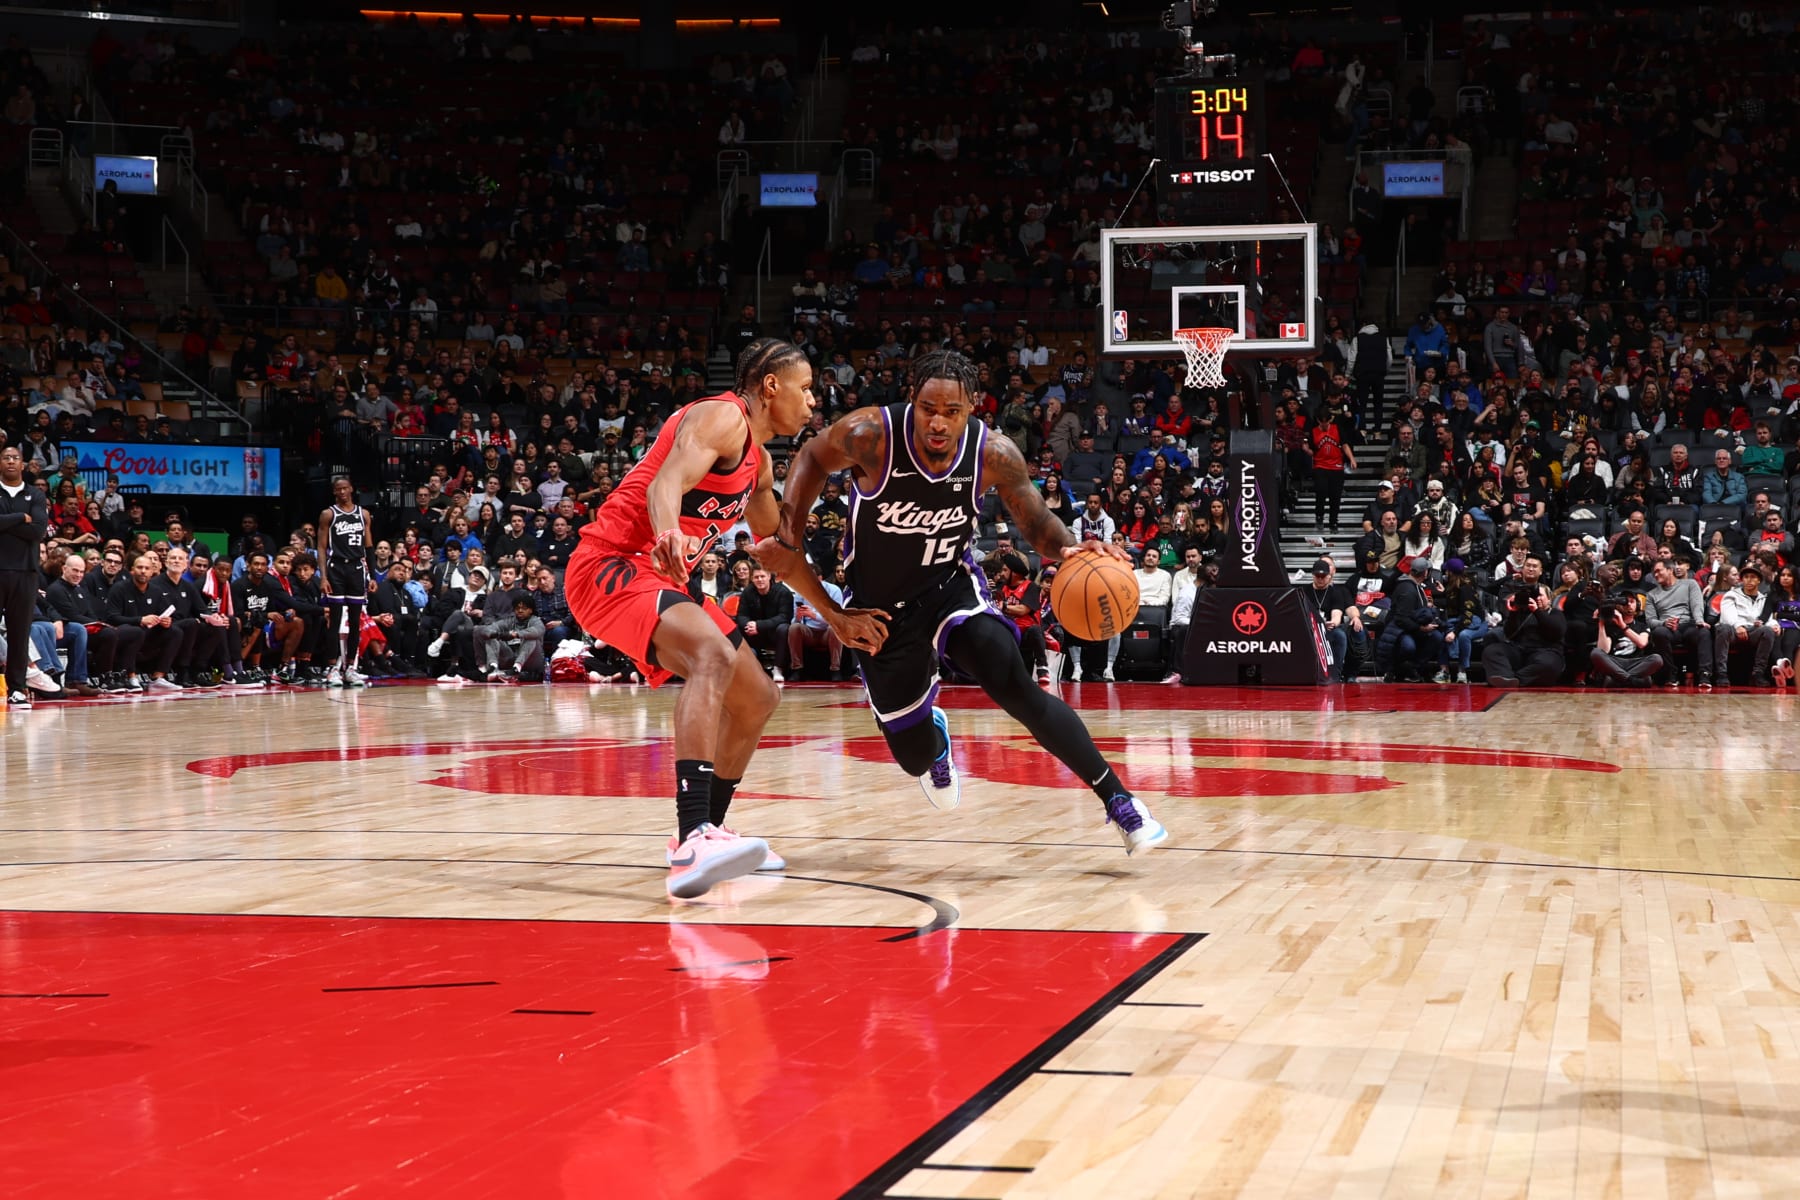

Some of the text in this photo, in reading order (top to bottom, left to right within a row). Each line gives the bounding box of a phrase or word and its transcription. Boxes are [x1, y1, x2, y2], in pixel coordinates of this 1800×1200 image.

[1191, 87, 1247, 114] 3:04
[1199, 114, 1244, 160] 14
[98, 170, 142, 178] AEROPLAN
[1193, 168, 1255, 183] TISSOT
[104, 448, 230, 476] Coors LIGHT
[334, 521, 363, 535] Kings
[877, 502, 968, 535] Kings
[1242, 460, 1260, 572] JACKPOTCITY
[348, 534, 362, 546] 23
[921, 535, 960, 566] 15
[1206, 641, 1291, 652] AEROPLAN
